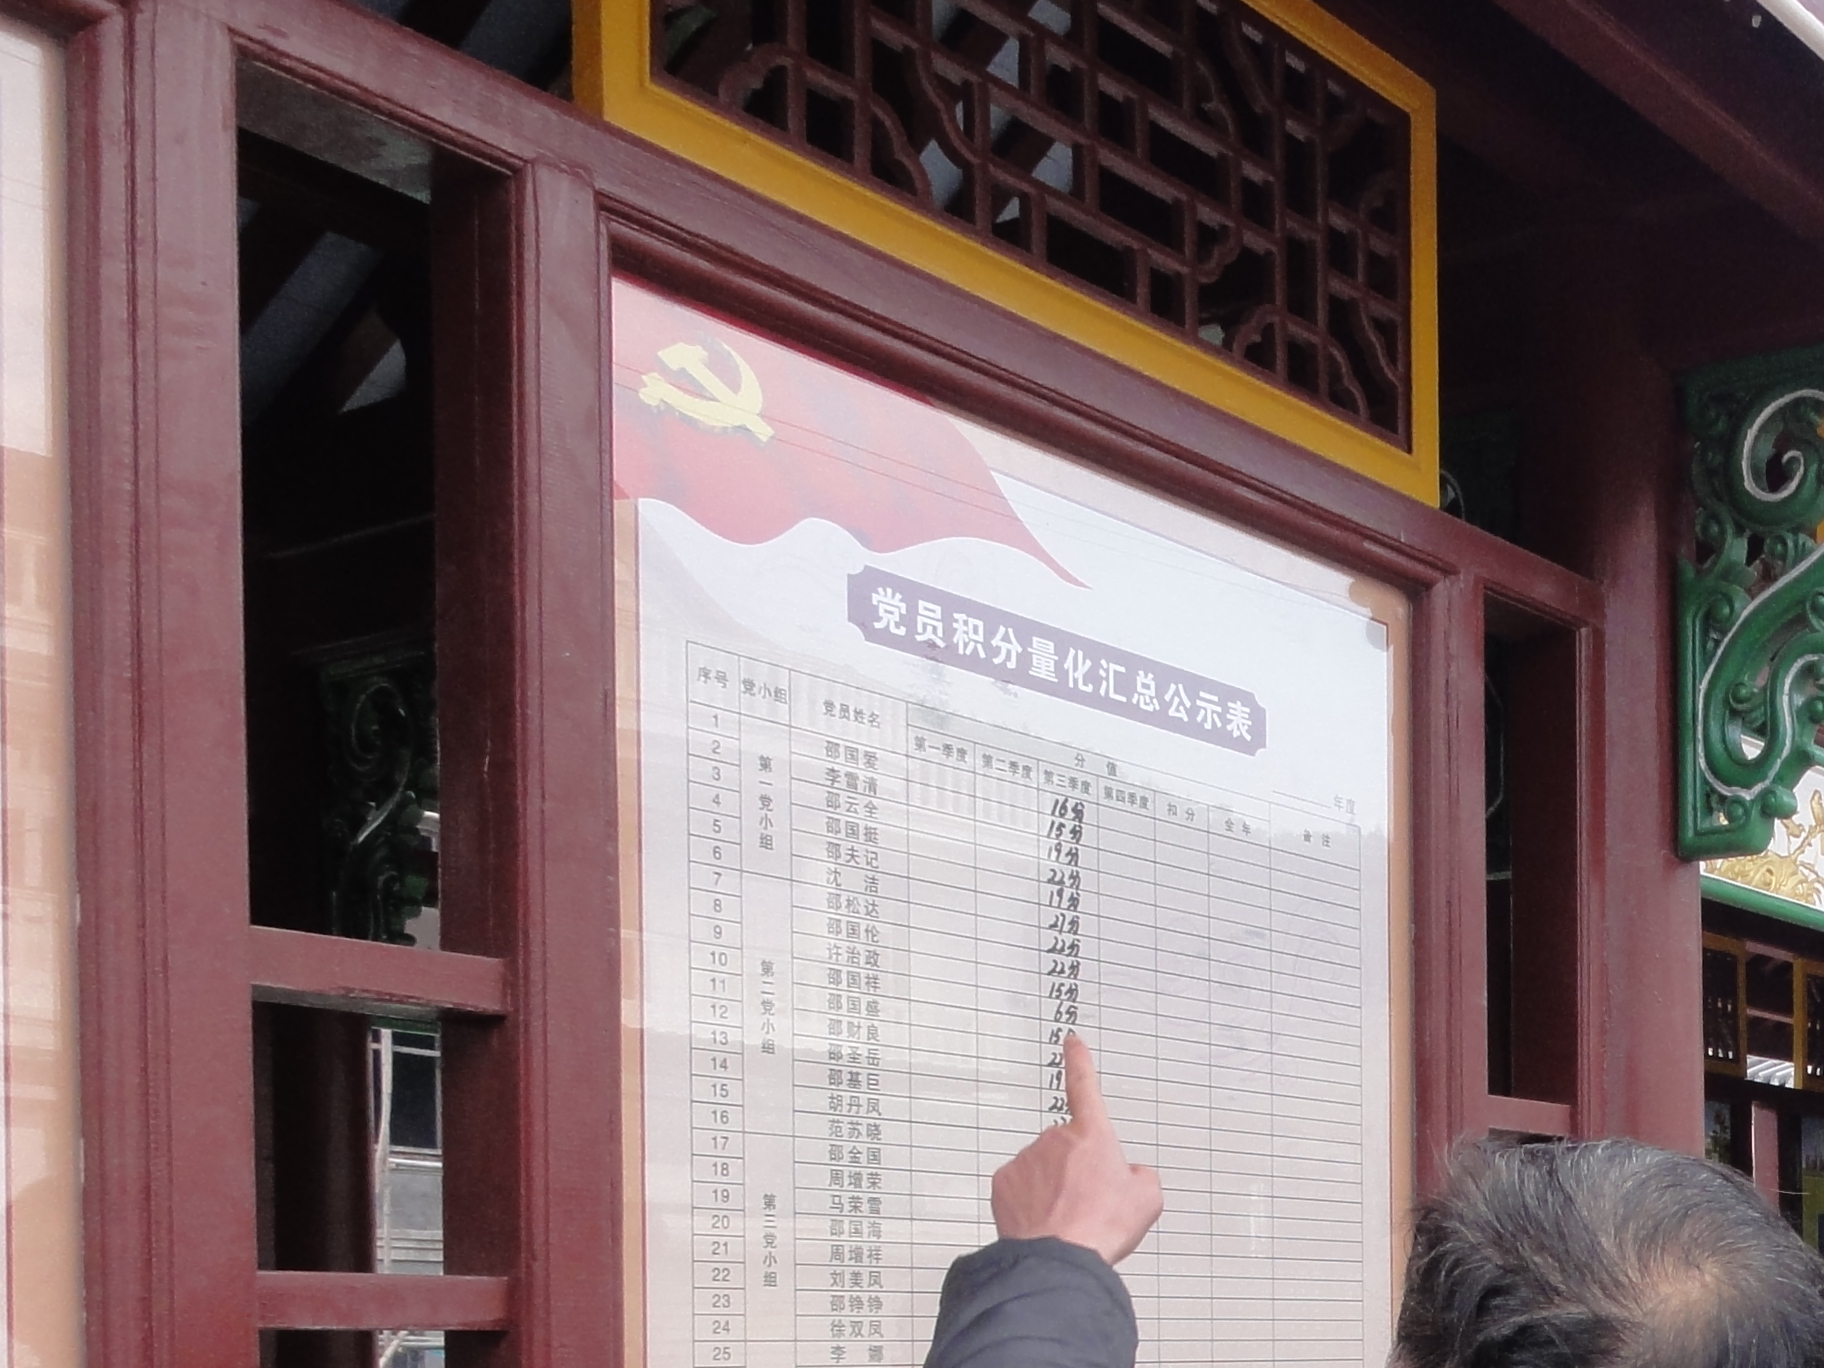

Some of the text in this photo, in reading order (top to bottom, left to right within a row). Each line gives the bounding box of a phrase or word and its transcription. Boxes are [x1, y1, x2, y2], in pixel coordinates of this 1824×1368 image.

[871, 586, 1253, 742] 党员积分量化汇总公示表
[696, 666, 729, 689] 序号
[741, 677, 789, 705] 党小组
[822, 699, 881, 729] 党员姓名
[711, 739, 721, 755] 2
[913, 735, 968, 764] 第一季度
[711, 766, 721, 782] 3
[981, 753, 1033, 782] 第二季度
[1043, 769, 1092, 796] 第三季度
[711, 793, 722, 807] 4
[758, 754, 774, 851] 第一党小组
[825, 791, 879, 819] 邵云全
[1103, 784, 1150, 811] 第四季度
[712, 818, 722, 834] 5
[712, 845, 722, 861] 6
[712, 871, 723, 886] 7
[713, 898, 723, 914] 8
[827, 892, 880, 918] 邵松达
[713, 924, 723, 940] 9
[827, 917, 880, 943] 邵国伦
[709, 950, 728, 967] 10
[827, 942, 880, 968] 许治政
[709, 977, 726, 992] 11
[827, 968, 881, 993] 邵国祥
[710, 1003, 728, 1020] 12
[759, 959, 776, 1056] 第二党小组
[711, 1030, 729, 1046] 13
[828, 1018, 880, 1042] 邵财良
[710, 1056, 729, 1072] 14
[711, 1082, 729, 1099] 15
[828, 1093, 882, 1116] 胡丹凤
[711, 1109, 730, 1125] 16
[828, 1119, 882, 1141] 范苏晓
[711, 1135, 729, 1150] 17
[828, 1144, 882, 1166] 邵金国
[711, 1161, 730, 1177] 18
[828, 1169, 882, 1190] 周增荣
[712, 1188, 730, 1204] 19
[829, 1195, 883, 1216] 马荣雪
[711, 1214, 730, 1230] 20
[829, 1219, 882, 1239] 邵国海
[711, 1240, 728, 1256] 21
[762, 1192, 778, 1288] 第三党小组
[829, 1244, 883, 1264] 周增祥
[711, 1267, 731, 1283] 22
[829, 1270, 884, 1289] 刘美凤
[712, 1293, 731, 1309] 23
[712, 1319, 731, 1335] 24
[830, 1319, 884, 1338] 徐双凤
[712, 1346, 732, 1361] 25
